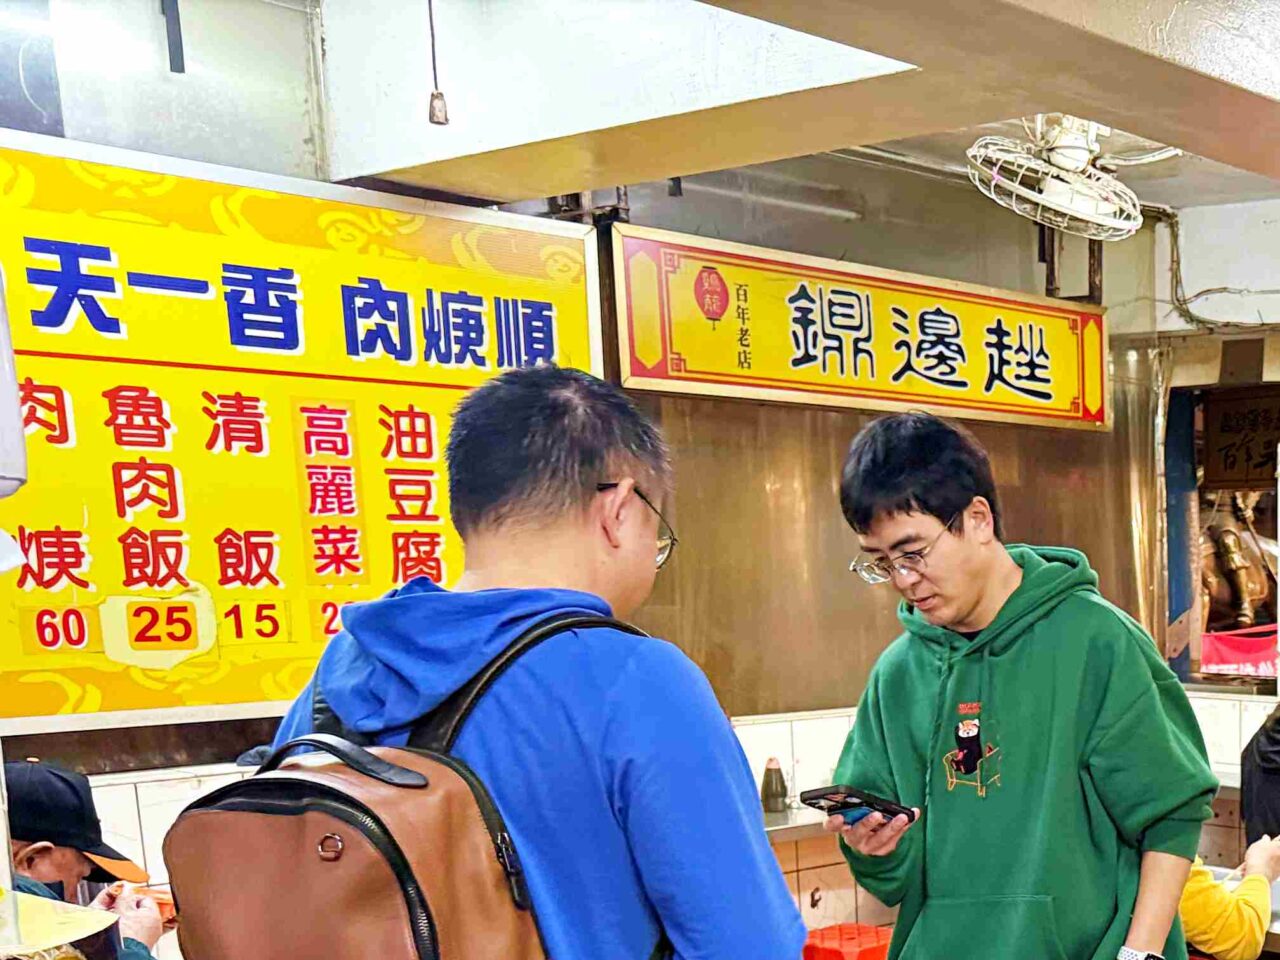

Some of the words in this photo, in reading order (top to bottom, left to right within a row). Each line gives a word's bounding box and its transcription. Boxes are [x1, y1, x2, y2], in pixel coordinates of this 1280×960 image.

[734, 283, 752, 370] 百年老店
[102, 385, 190, 588] 魯肉飯
[202, 391, 279, 587] 清飯
[300, 405, 361, 575] 高麗菜
[378, 404, 444, 584] 油豆腐
[36, 608, 86, 647] 60
[132, 606, 192, 643] 25
[224, 603, 279, 639] 15
